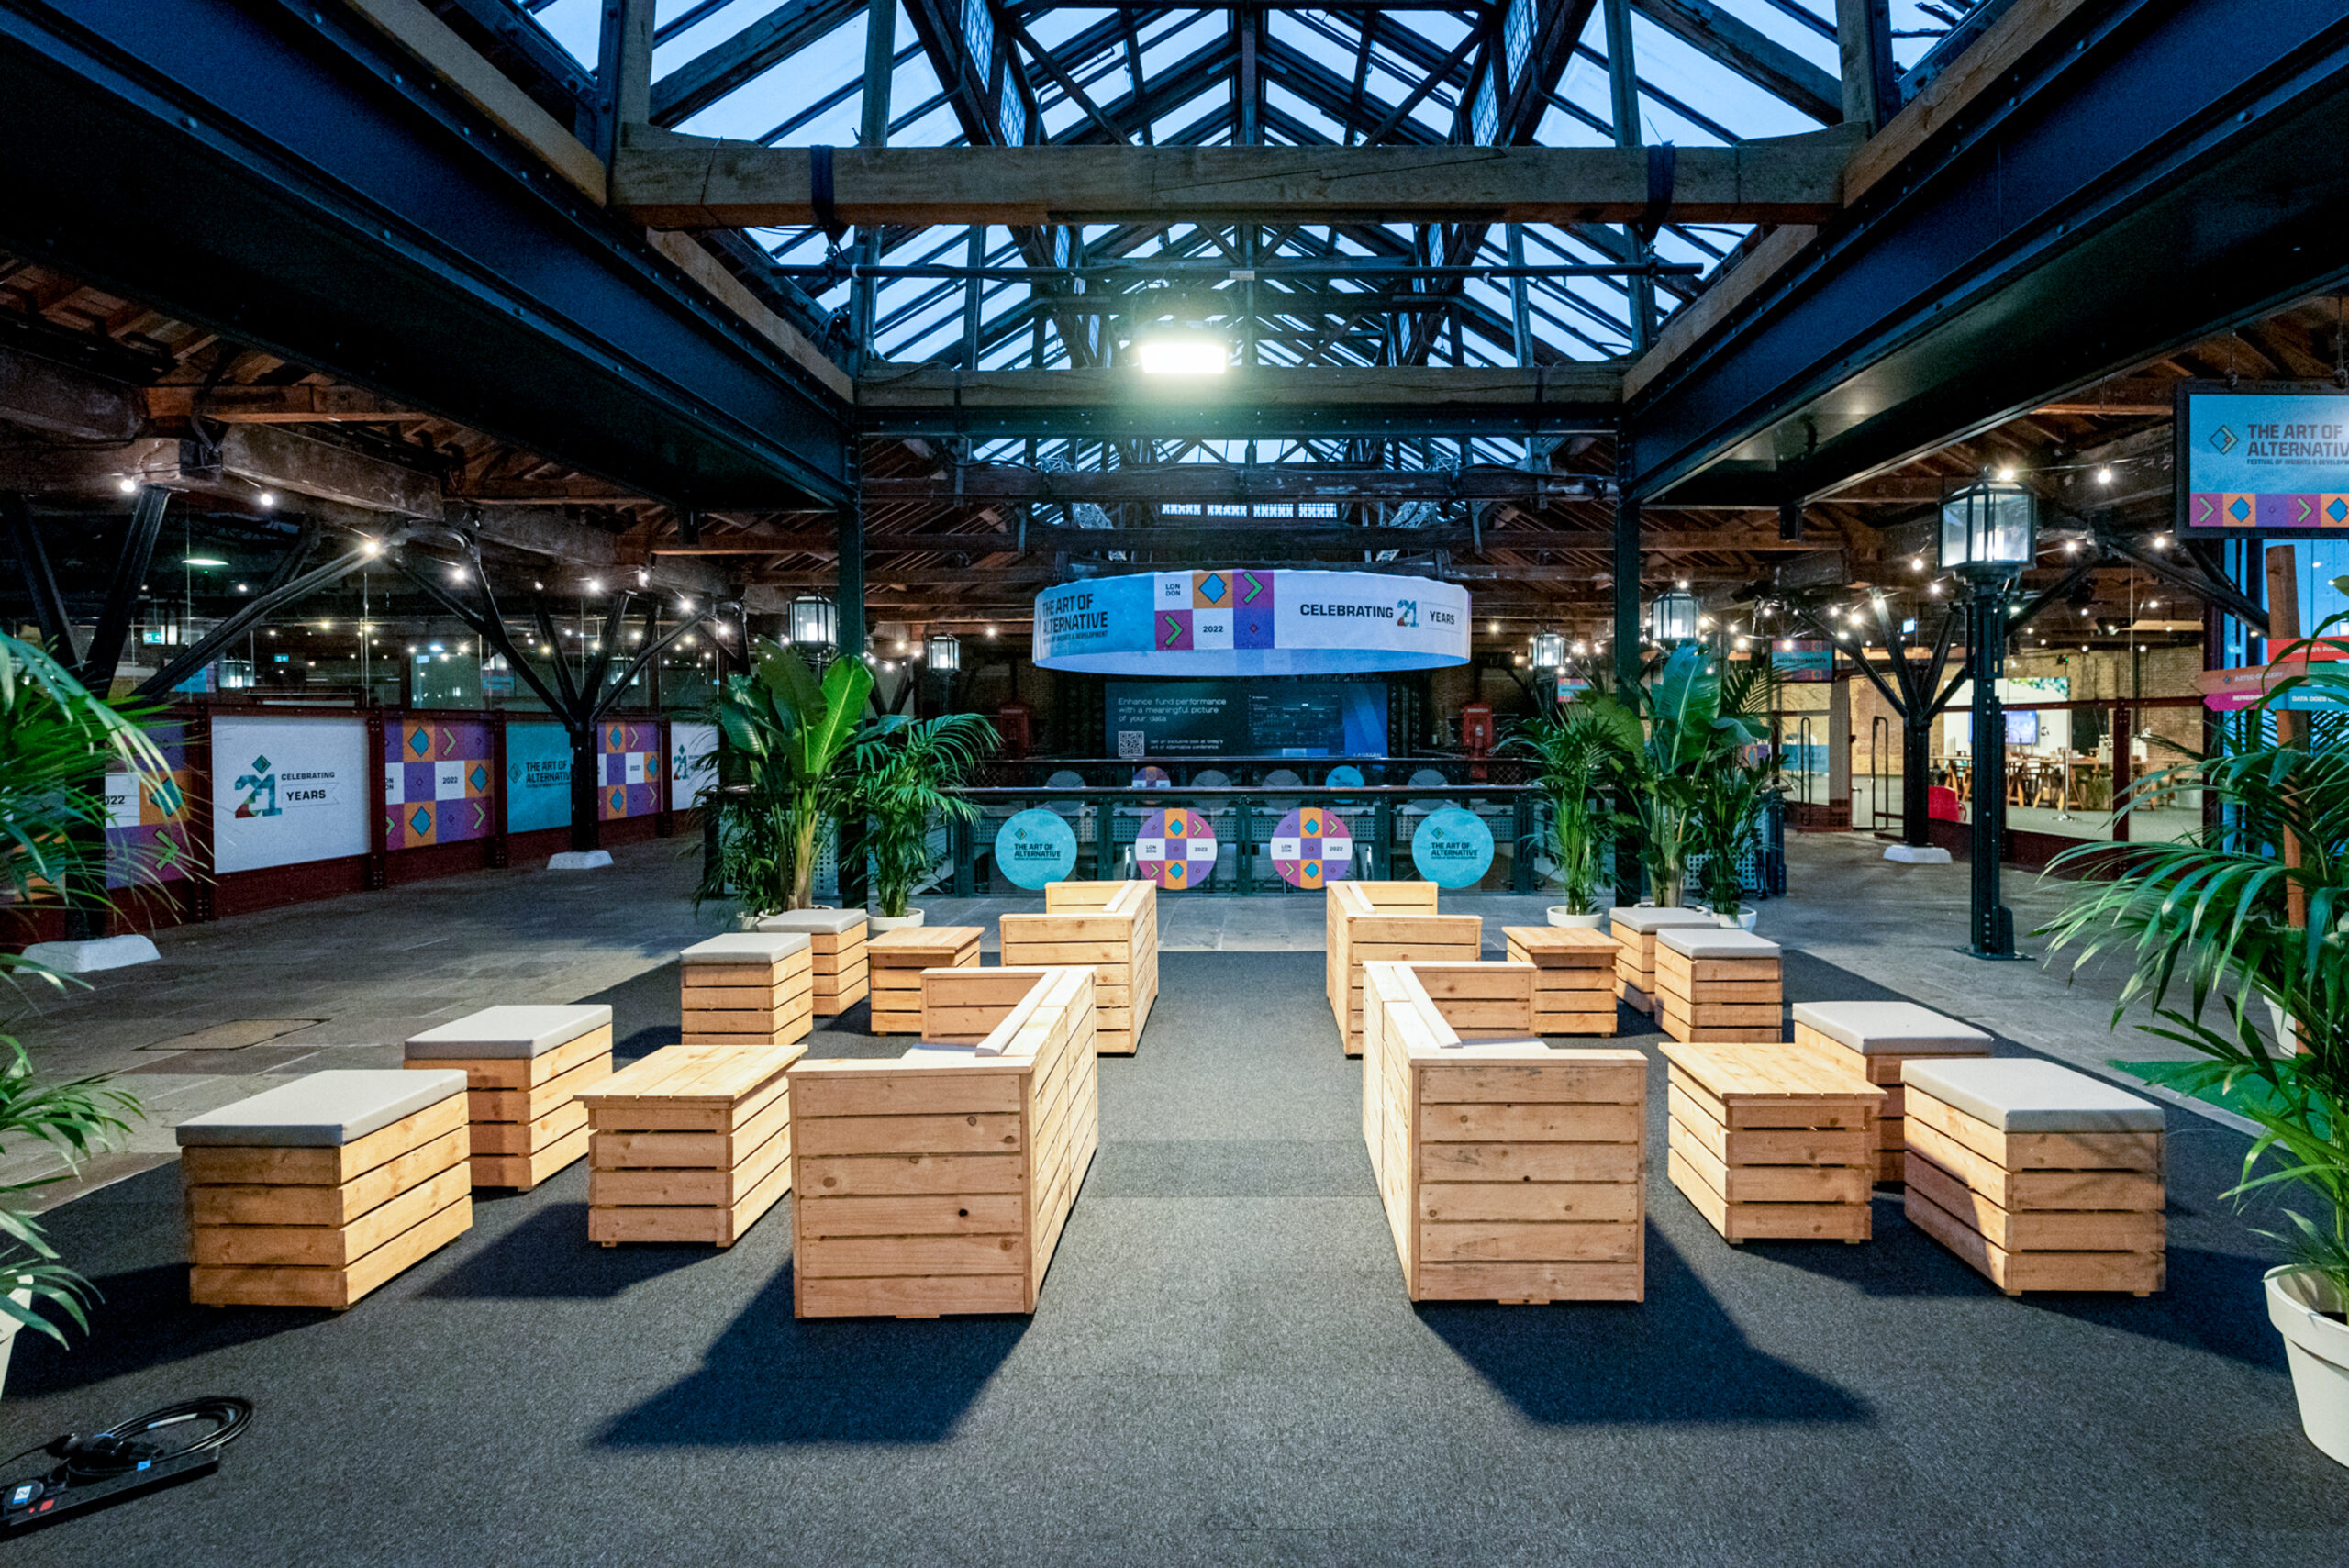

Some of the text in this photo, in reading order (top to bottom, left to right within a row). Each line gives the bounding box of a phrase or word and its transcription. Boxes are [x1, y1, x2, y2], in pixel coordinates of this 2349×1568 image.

[2247, 424, 2343, 439] THE ART OF
[2247, 441, 2349, 457] ALTERNATIV
[1042, 593, 1094, 617] THE ART OF
[1300, 599, 1455, 628] CELEBRATING 21 YEARS
[1175, 698, 1227, 706] performance
[1145, 706, 1189, 716] meaningful
[1191, 706, 1219, 715] picture
[526, 760, 567, 772] THE ART OF
[281, 772, 335, 781] CELEBRATING
[442, 776, 458, 784] 2022
[526, 772, 572, 783] ALTERNATIV
[105, 795, 125, 806] 022
[235, 773, 327, 818] 21 YEARS
